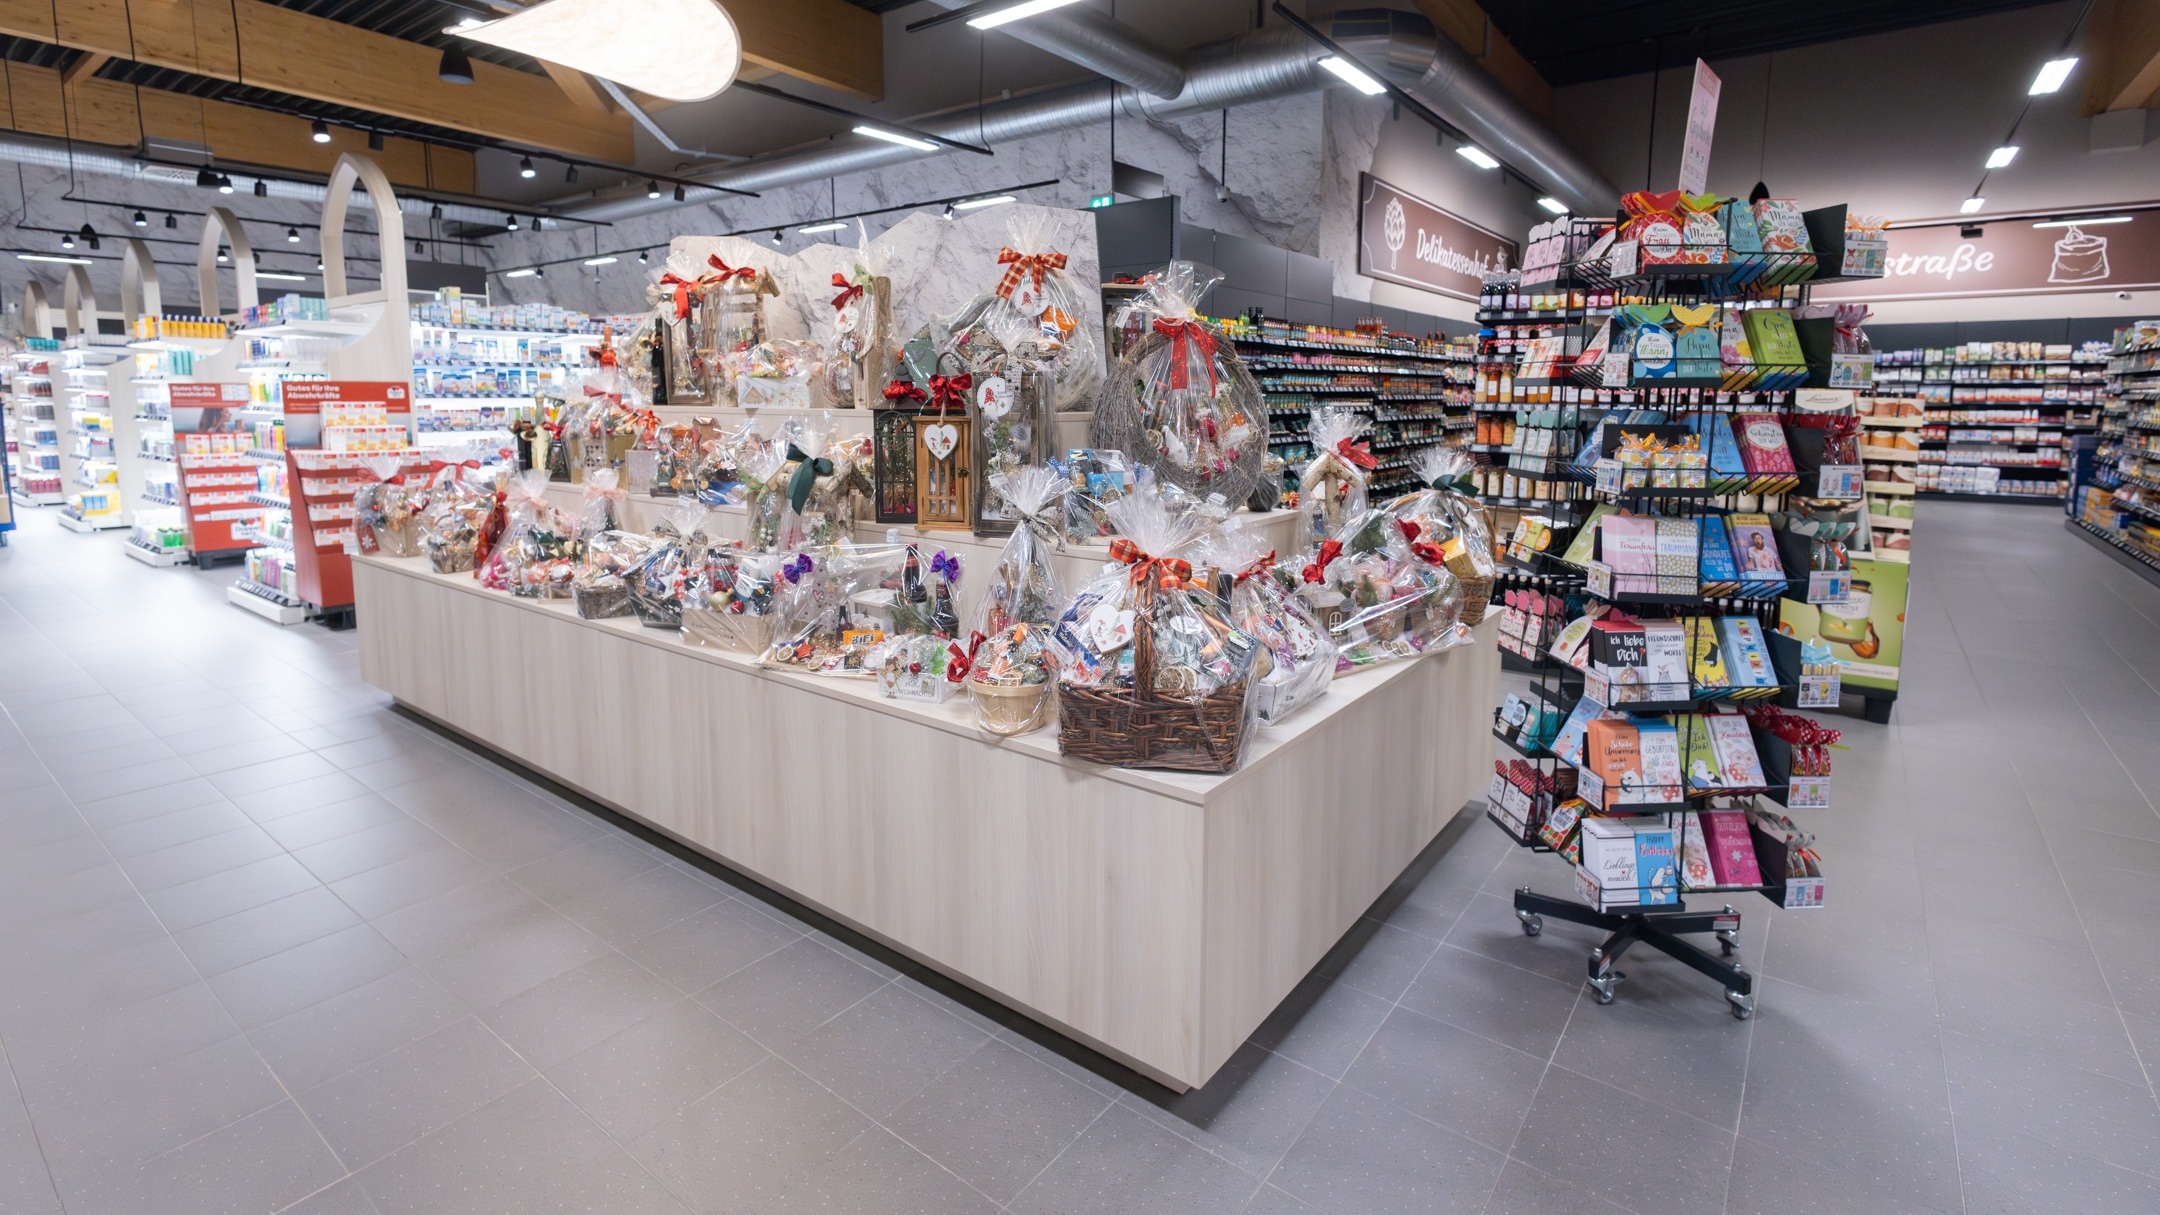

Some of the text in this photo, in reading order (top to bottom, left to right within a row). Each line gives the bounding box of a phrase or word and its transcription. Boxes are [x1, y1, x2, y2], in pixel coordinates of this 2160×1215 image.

[1646, 234, 1671, 245] Frau
[1415, 228, 1490, 280] Delikatessenhof
[1639, 344, 1666, 355] Mann
[1685, 338, 1711, 358] Papa
[286, 384, 308, 392] Gutes
[310, 384, 324, 392] für
[286, 392, 341, 400] Abwehrkräfte
[1619, 541, 1656, 552] Traumfrau
[1610, 634, 1645, 647] Ich liebe
[1616, 647, 1639, 662] Dich
[900, 688, 936, 699] WEIHNACHTEN
[1644, 744, 1678, 754] GEBURTSTAG
[1673, 818, 1698, 830] Dake
[1639, 843, 1674, 857] Birthday
